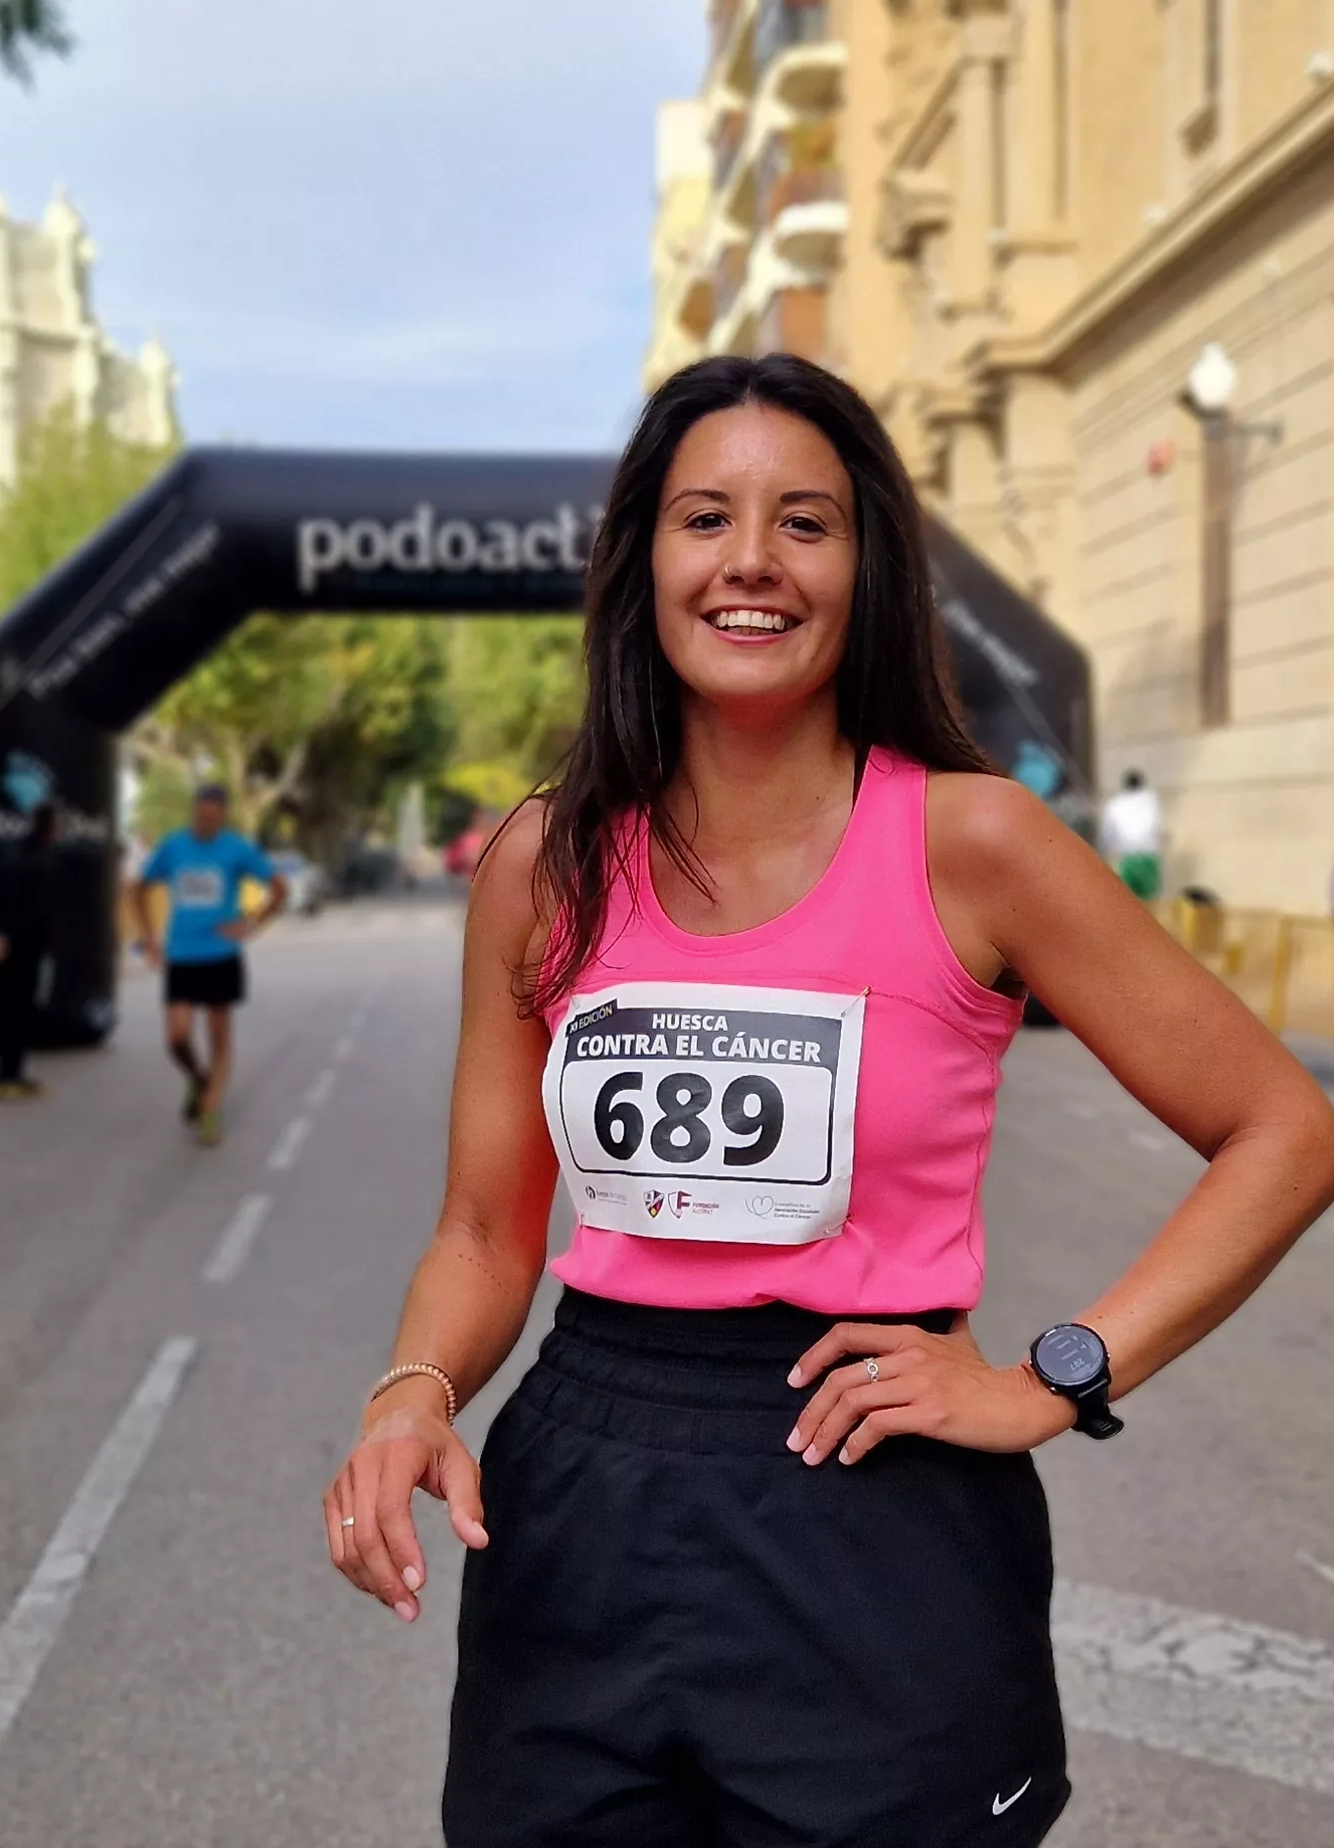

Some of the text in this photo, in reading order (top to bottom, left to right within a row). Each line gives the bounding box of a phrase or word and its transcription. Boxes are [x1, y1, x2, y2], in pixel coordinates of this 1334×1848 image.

[298, 502, 605, 593] podoact
[578, 1004, 613, 1029] EDICIÓN
[652, 1013, 729, 1031] HUESCA
[576, 1032, 821, 1063] CONTRA EL CÁNCER
[593, 1071, 785, 1167] 689
